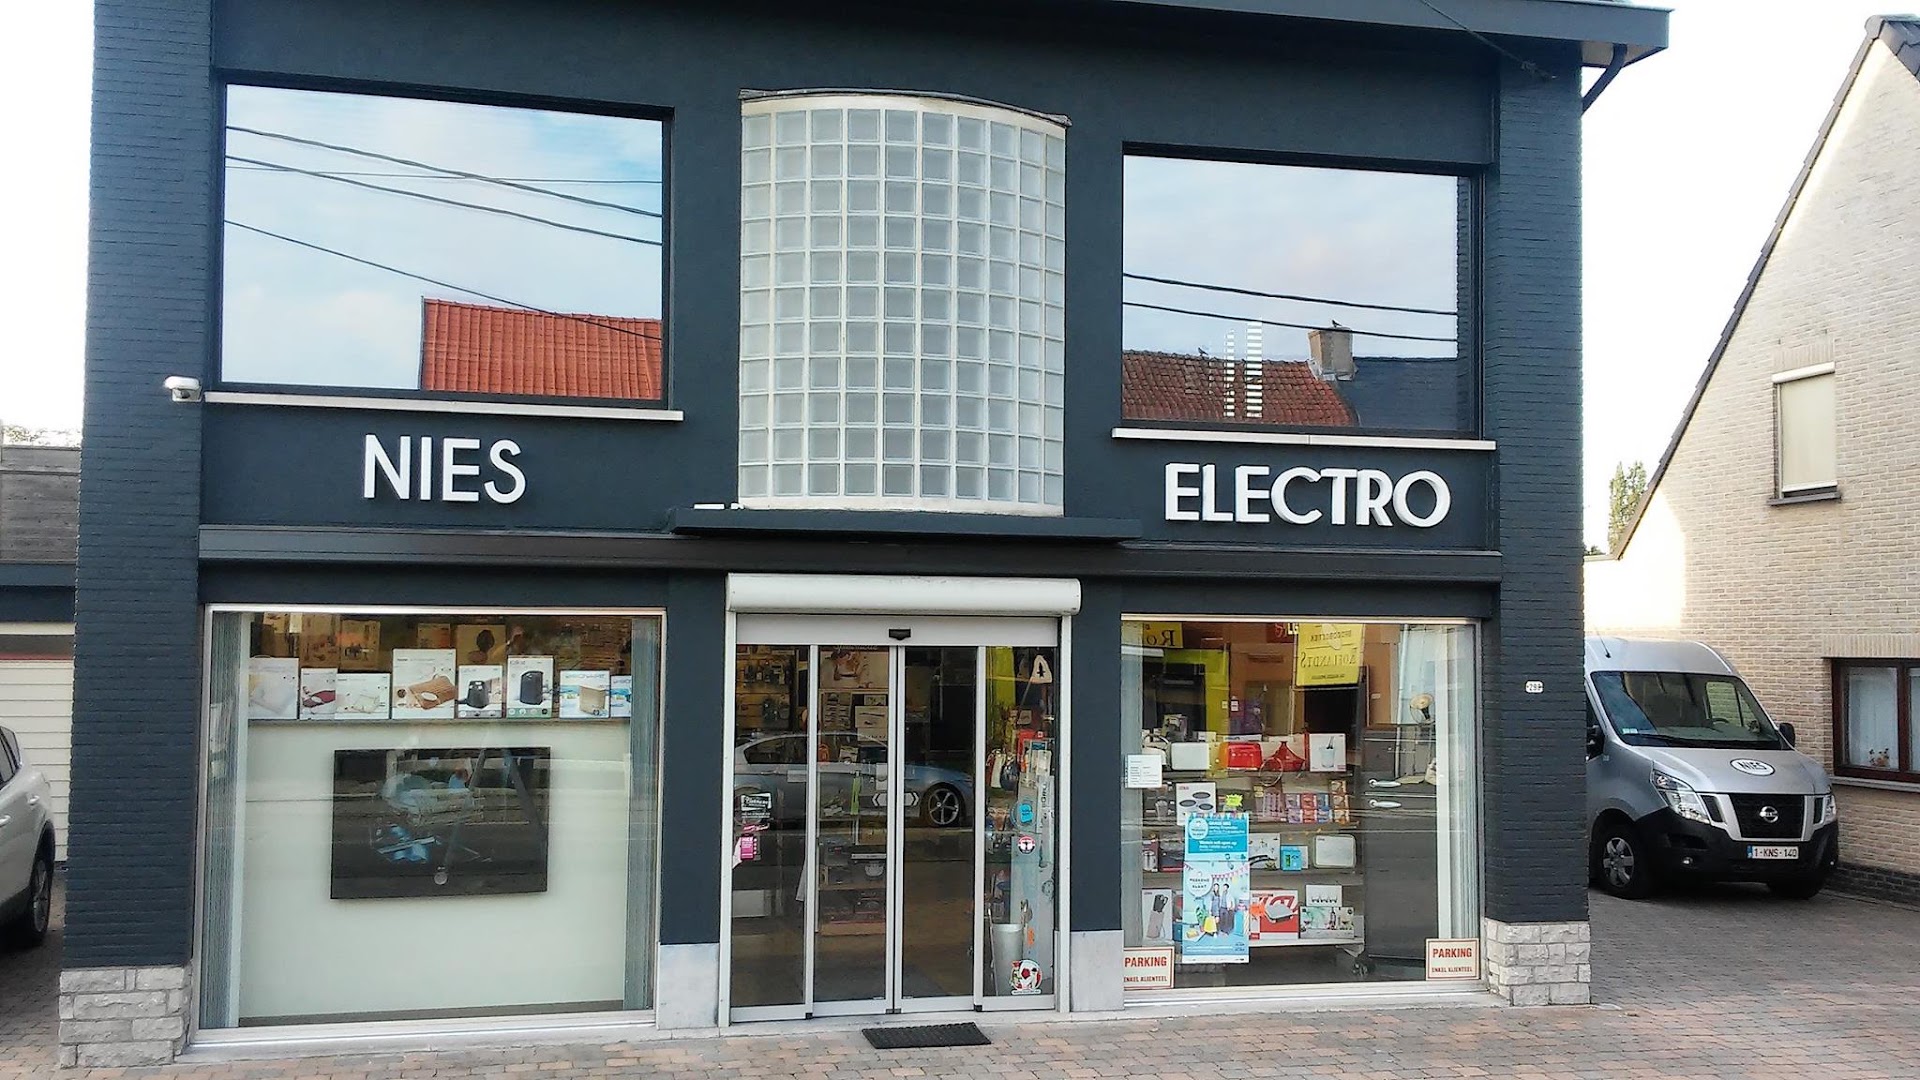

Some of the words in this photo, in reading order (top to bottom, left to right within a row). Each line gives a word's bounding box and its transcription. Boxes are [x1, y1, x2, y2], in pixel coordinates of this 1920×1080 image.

[363, 433, 526, 504] NIES
[1165, 462, 1451, 527] ELECTRO
[1124, 956, 1168, 968] PARKING
[1432, 947, 1473, 958] PARKING
